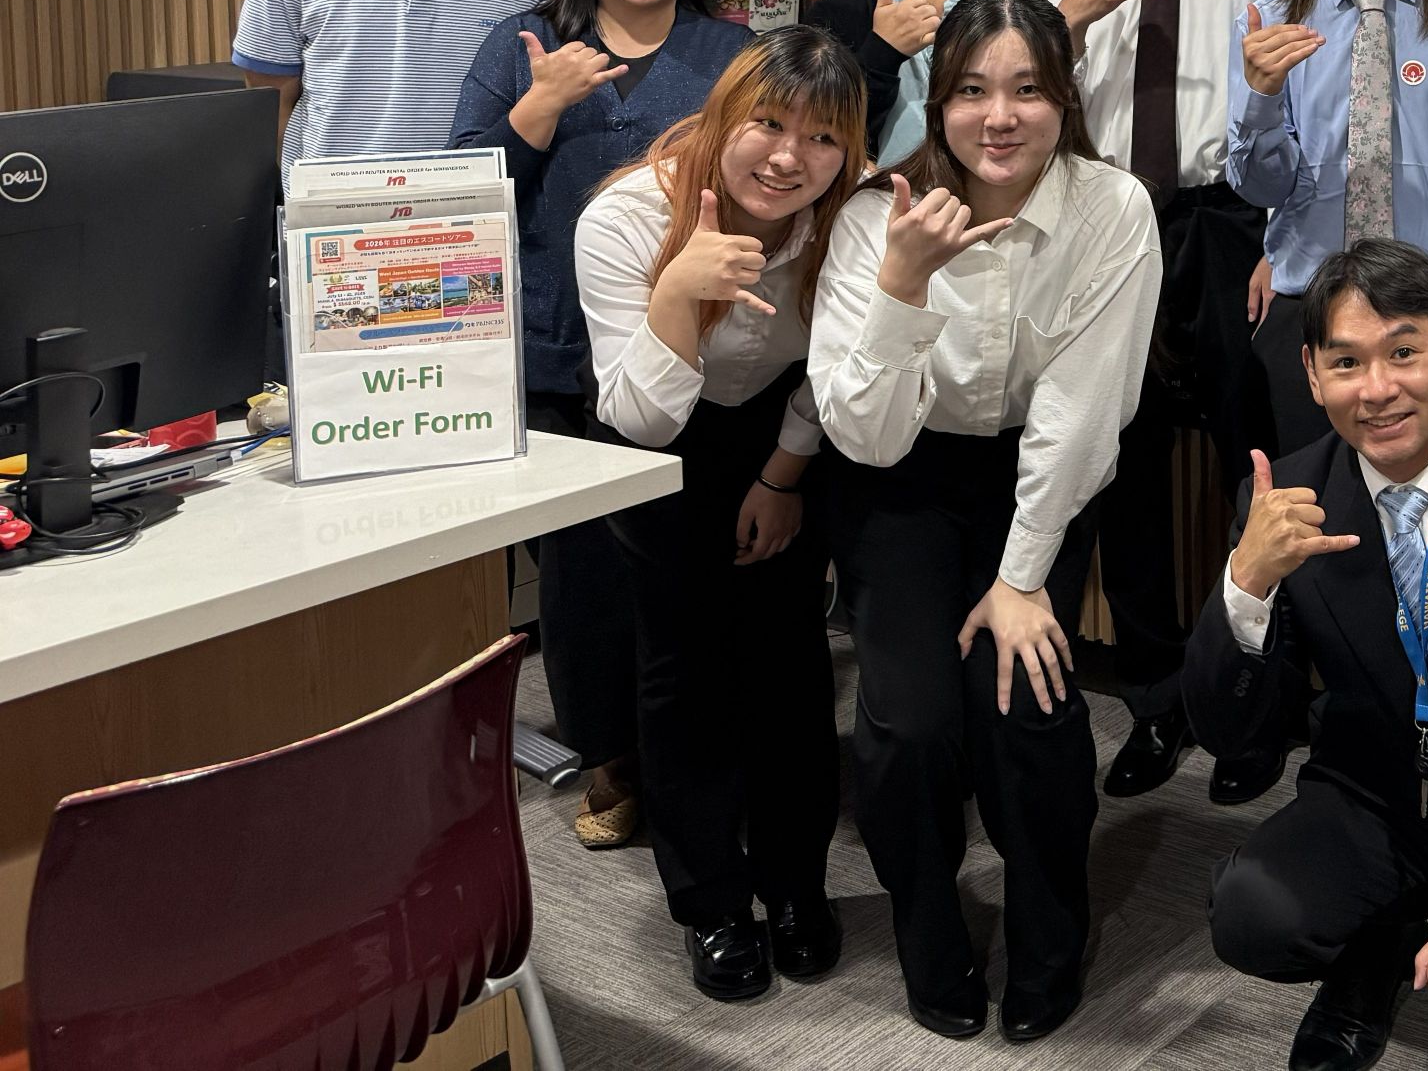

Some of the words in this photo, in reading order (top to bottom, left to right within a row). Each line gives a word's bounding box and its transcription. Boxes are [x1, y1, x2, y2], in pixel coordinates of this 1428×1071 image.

[2, 169, 43, 186] DELL
[390, 206, 413, 219] JTB
[362, 364, 443, 394] Wi-Fi
[311, 415, 405, 445] Order
[414, 411, 493, 436] Form
